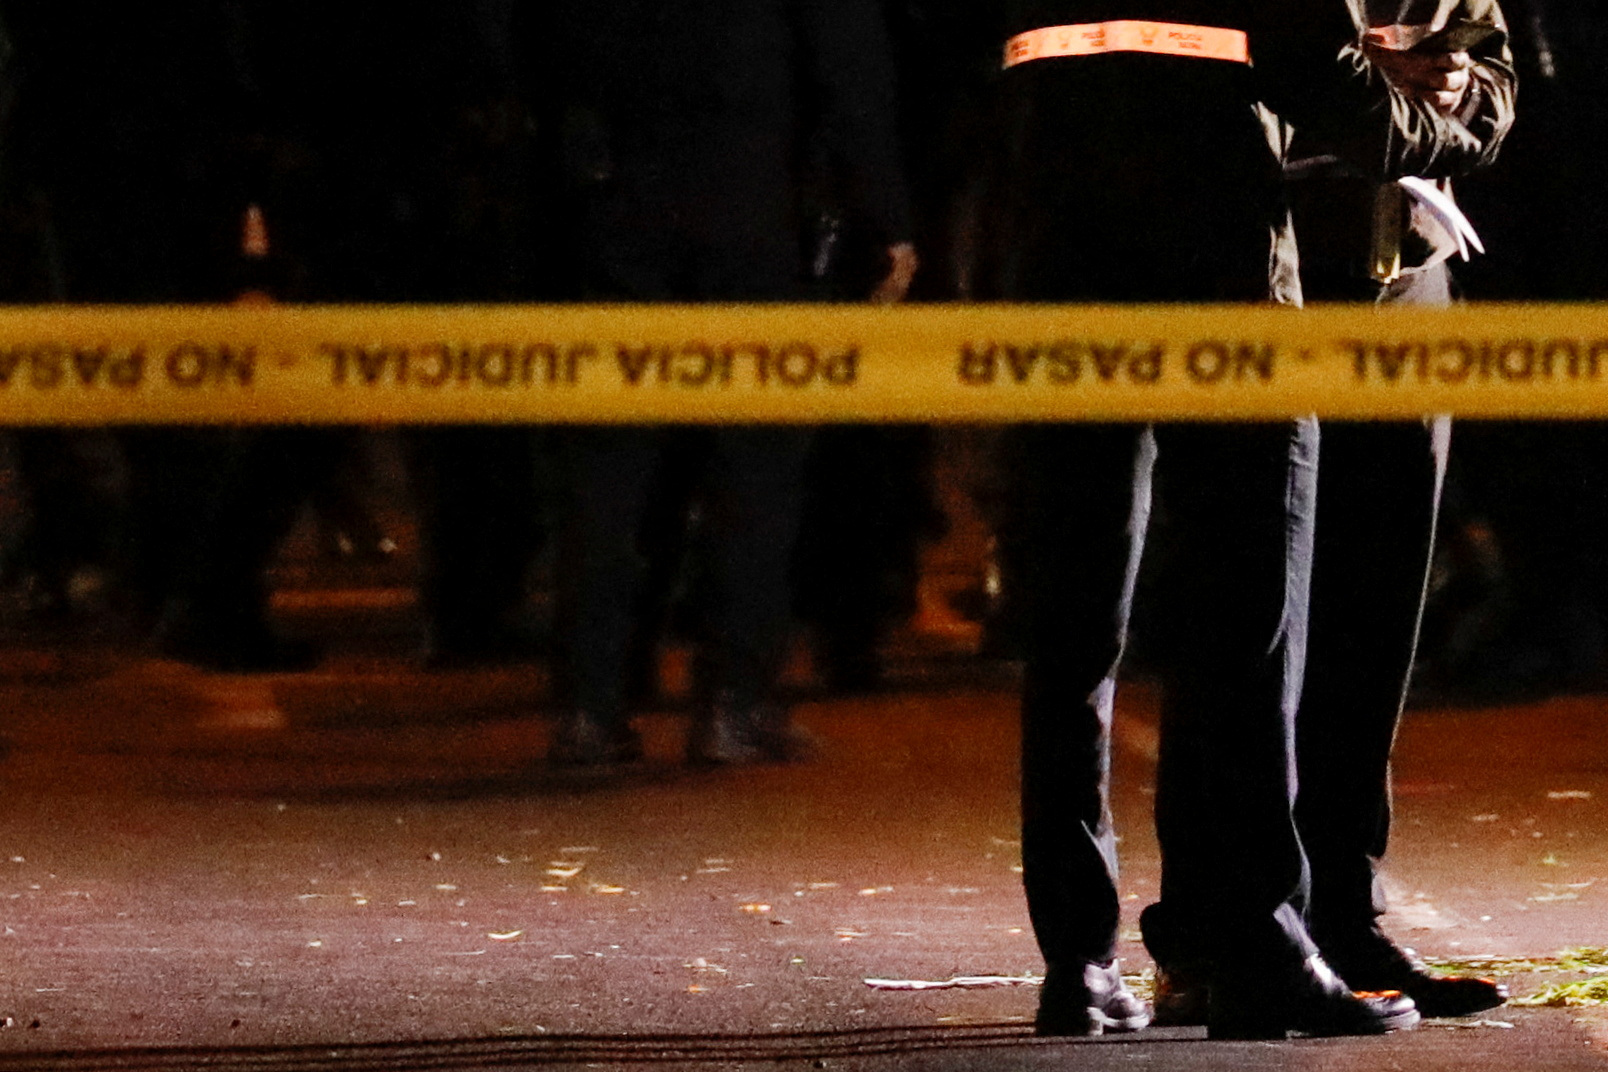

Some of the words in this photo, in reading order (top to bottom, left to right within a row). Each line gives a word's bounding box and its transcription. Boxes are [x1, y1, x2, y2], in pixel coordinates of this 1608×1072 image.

[164, 344, 257, 388] NO
[319, 343, 597, 387] JUDICIAL
[613, 343, 862, 388] POLICIA
[957, 340, 1166, 384] PASAR
[1184, 339, 1278, 383] NO
